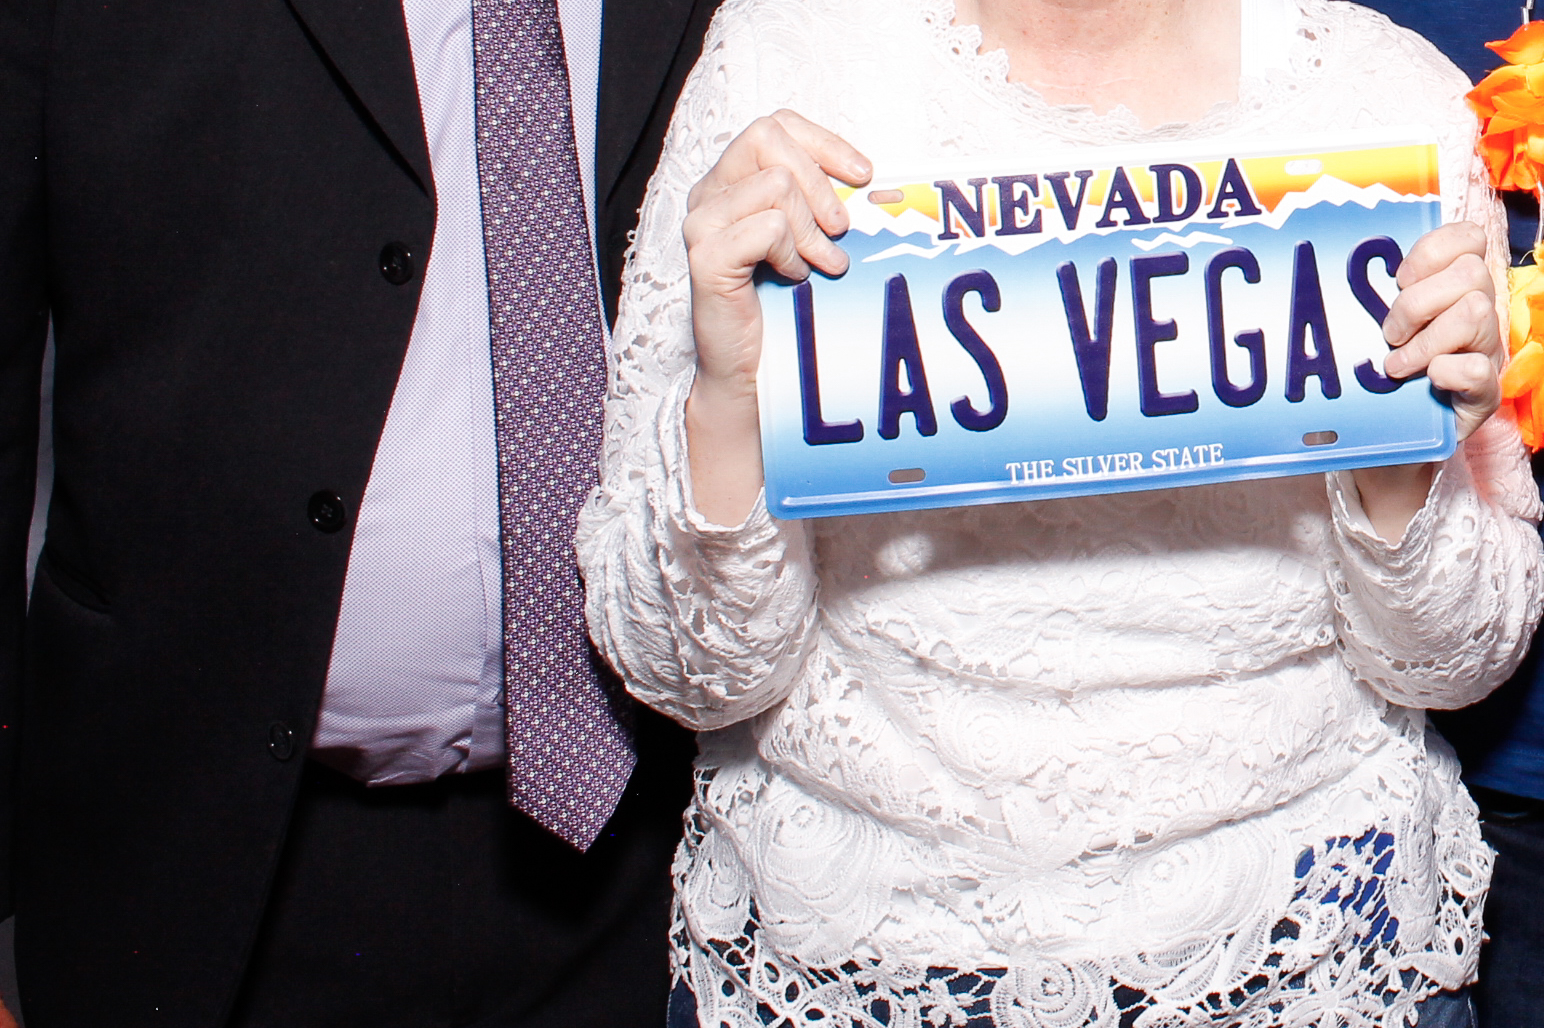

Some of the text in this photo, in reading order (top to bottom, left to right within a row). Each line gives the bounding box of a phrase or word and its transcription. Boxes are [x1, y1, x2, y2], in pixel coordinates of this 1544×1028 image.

[934, 157, 1262, 241] NEVADA
[792, 235, 1404, 446] LAS VEGAS
[1006, 443, 1225, 485] THE SILVER STATE
